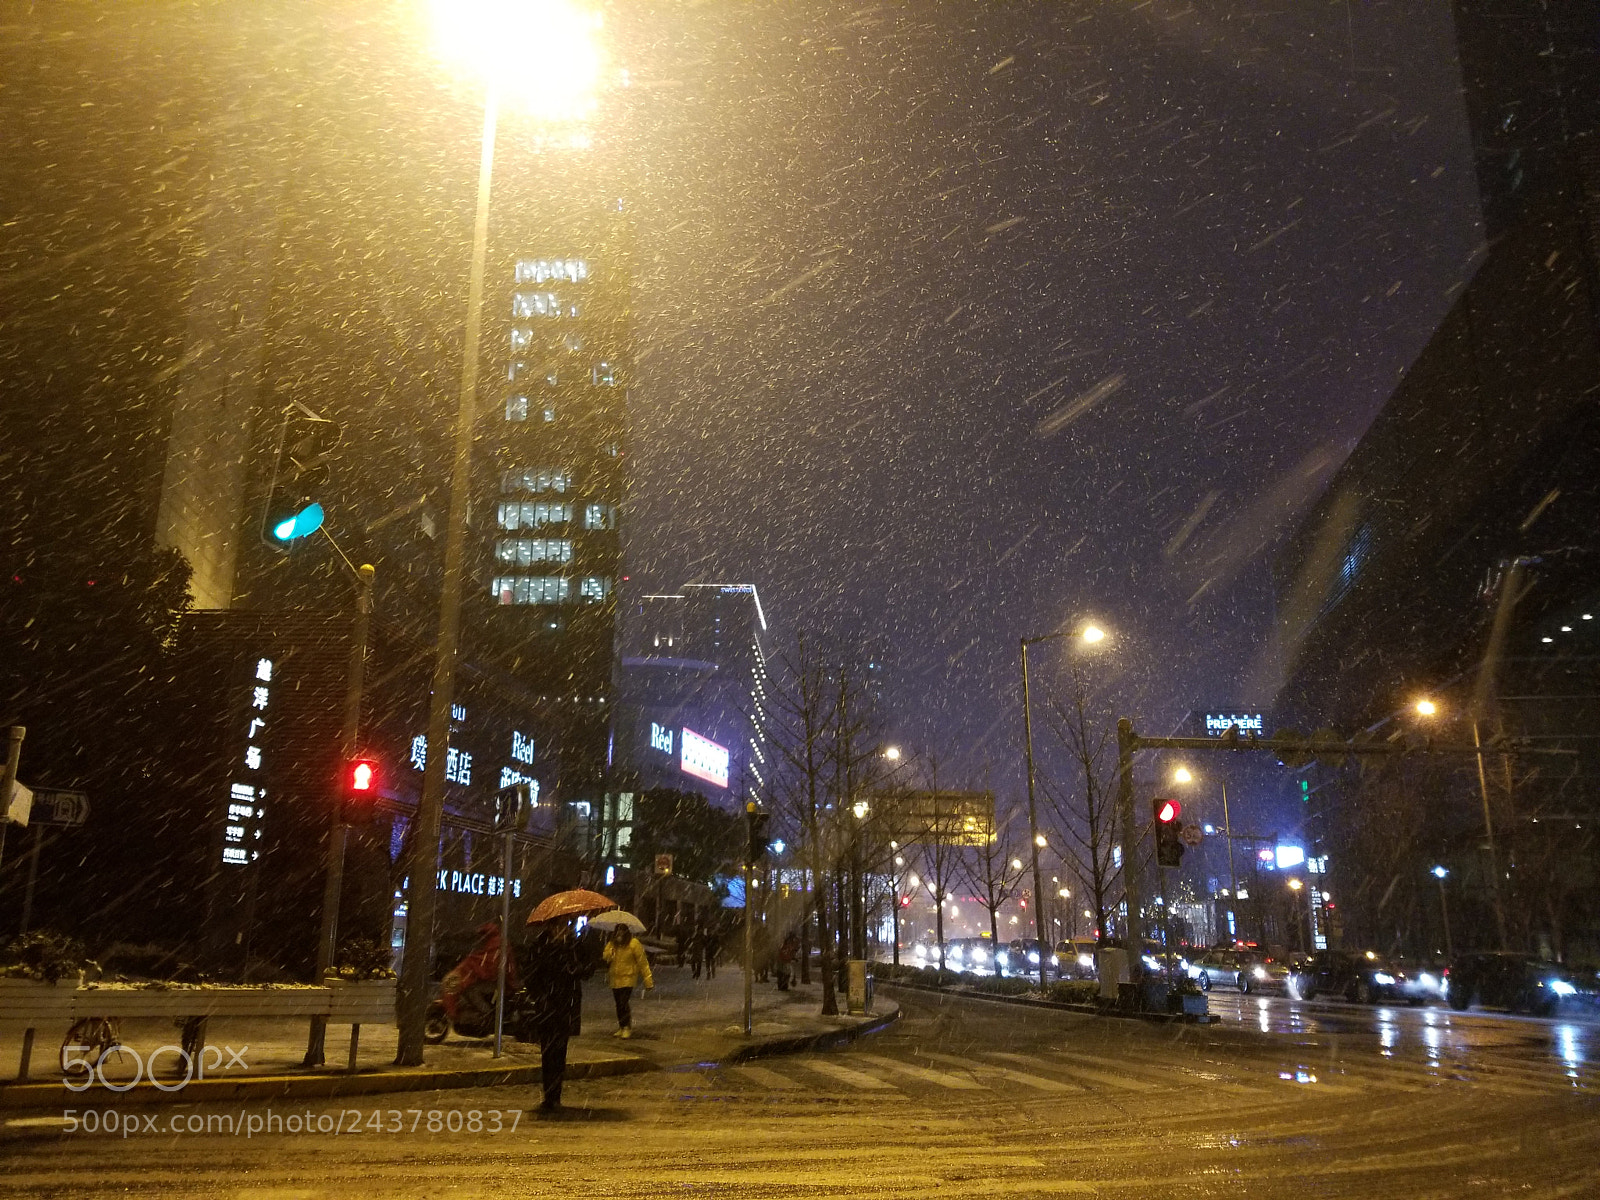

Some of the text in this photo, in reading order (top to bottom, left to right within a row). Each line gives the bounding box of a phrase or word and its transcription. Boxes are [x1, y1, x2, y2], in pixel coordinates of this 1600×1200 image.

[244, 658, 273, 770] 越洋广场
[511, 730, 535, 765] Réel
[651, 722, 673, 755] Réel
[410, 734, 472, 786] 璞酒店
[451, 870, 485, 895] PLACE
[487, 875, 521, 898] 越洋场
